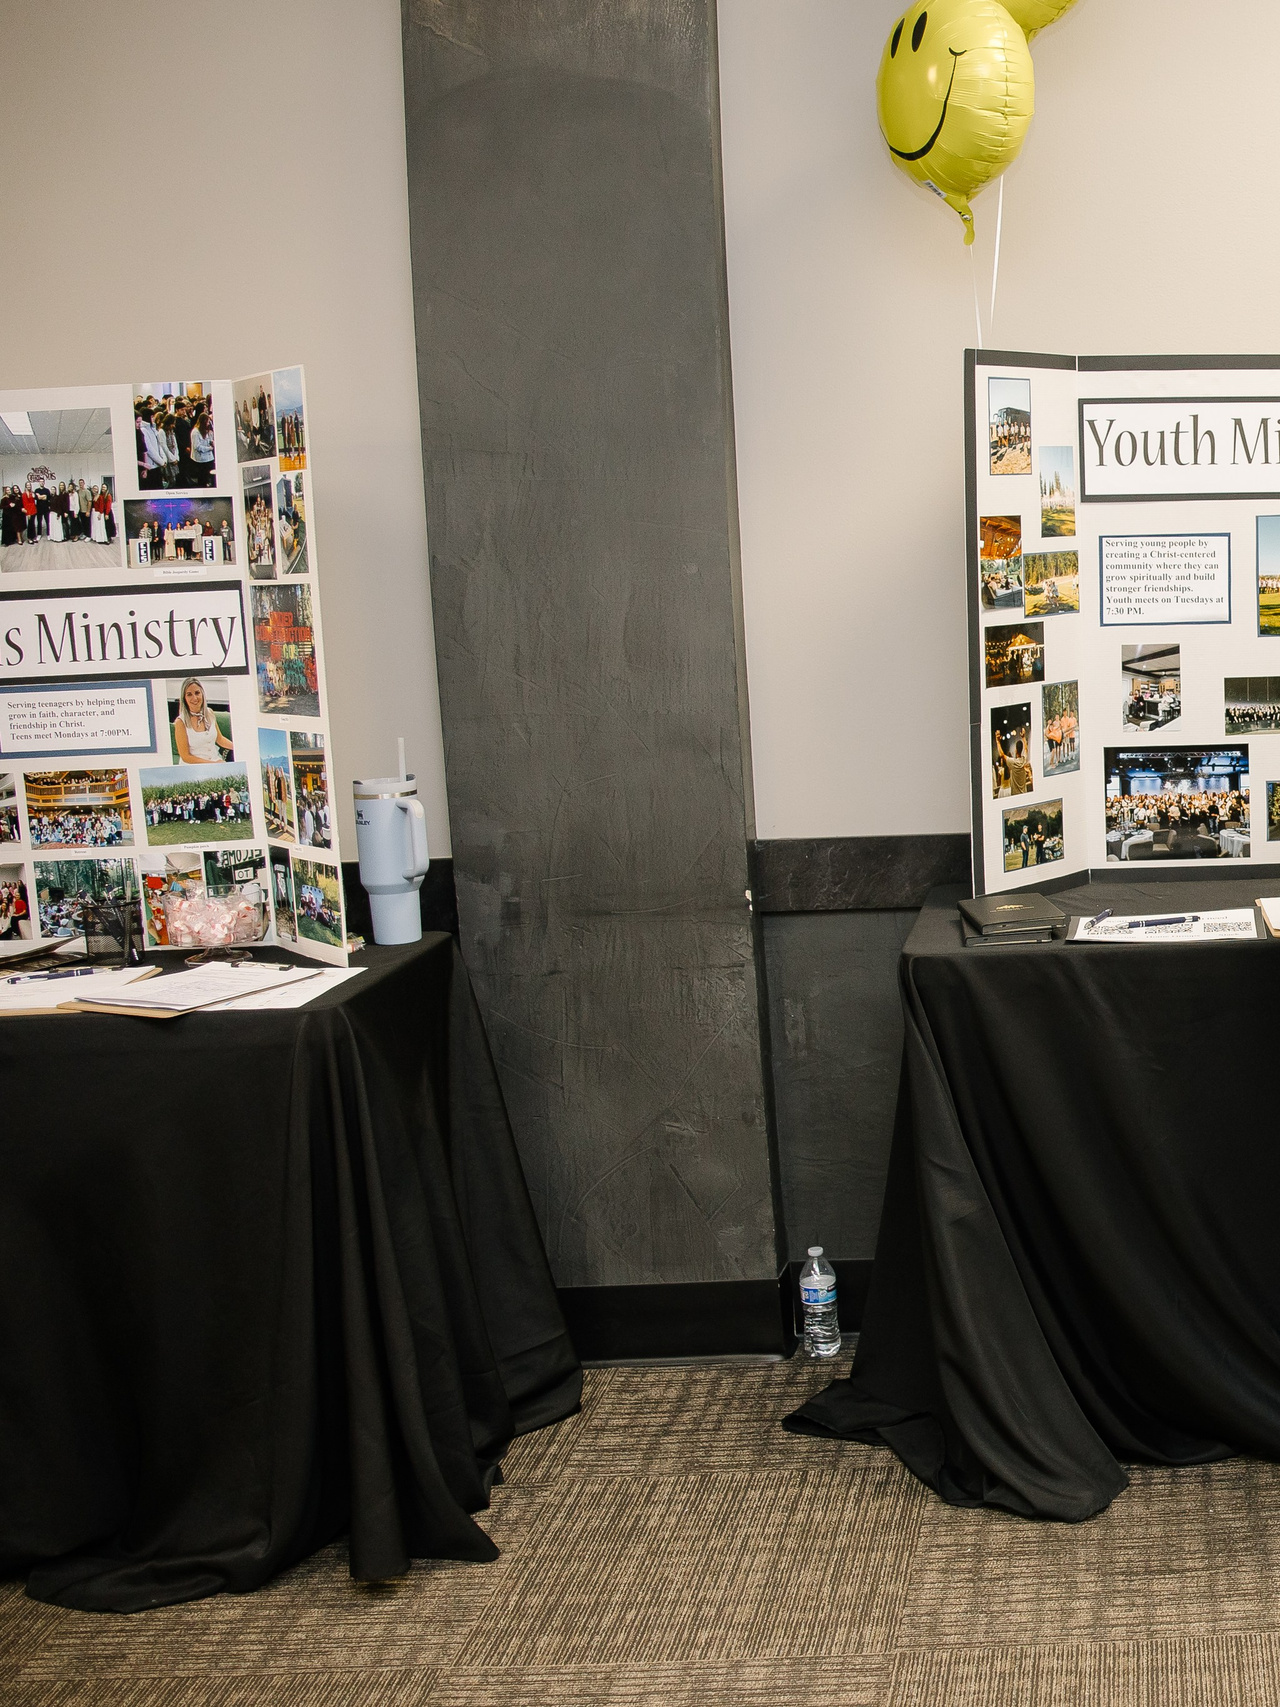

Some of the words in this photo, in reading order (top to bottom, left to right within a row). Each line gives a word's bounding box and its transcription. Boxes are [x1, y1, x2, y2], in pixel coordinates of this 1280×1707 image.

[1085, 413, 1218, 467] Youth
[1105, 540, 1138, 548] Serving
[1168, 540, 1196, 548] people
[1198, 540, 1208, 548] by
[1106, 551, 1140, 560] creating
[1150, 550, 1216, 558] Christ-centered
[1106, 562, 1153, 572] community
[1156, 562, 1182, 570] where
[1184, 562, 1202, 572] they
[1130, 573, 1172, 582] spiritually
[1106, 585, 1142, 594] stronger
[1144, 584, 1194, 594] friendships.
[1106, 596, 1132, 604] Youth
[1134, 596, 1159, 604] meets
[1174, 596, 1214, 605] Tuesdays
[1216, 596, 1224, 604] at
[1106, 607, 1124, 615] 7:30
[1127, 607, 1144, 615] PM.
[34, 609, 237, 669] Ministry
[7, 701, 36, 710] Serving
[38, 700, 74, 709] teenagers
[75, 699, 84, 708] by
[86, 698, 115, 708] helping
[8, 712, 27, 720] grow
[38, 710, 59, 718] faith,
[60, 710, 98, 718] character,
[100, 708, 115, 716] and
[10, 722, 48, 730] friendship
[58, 720, 85, 728] Christ.
[10, 732, 32, 740] Teens
[34, 732, 52, 740] meet
[54, 730, 88, 740] Mondays
[90, 730, 98, 738] at
[100, 728, 132, 738] 7:00PM.
